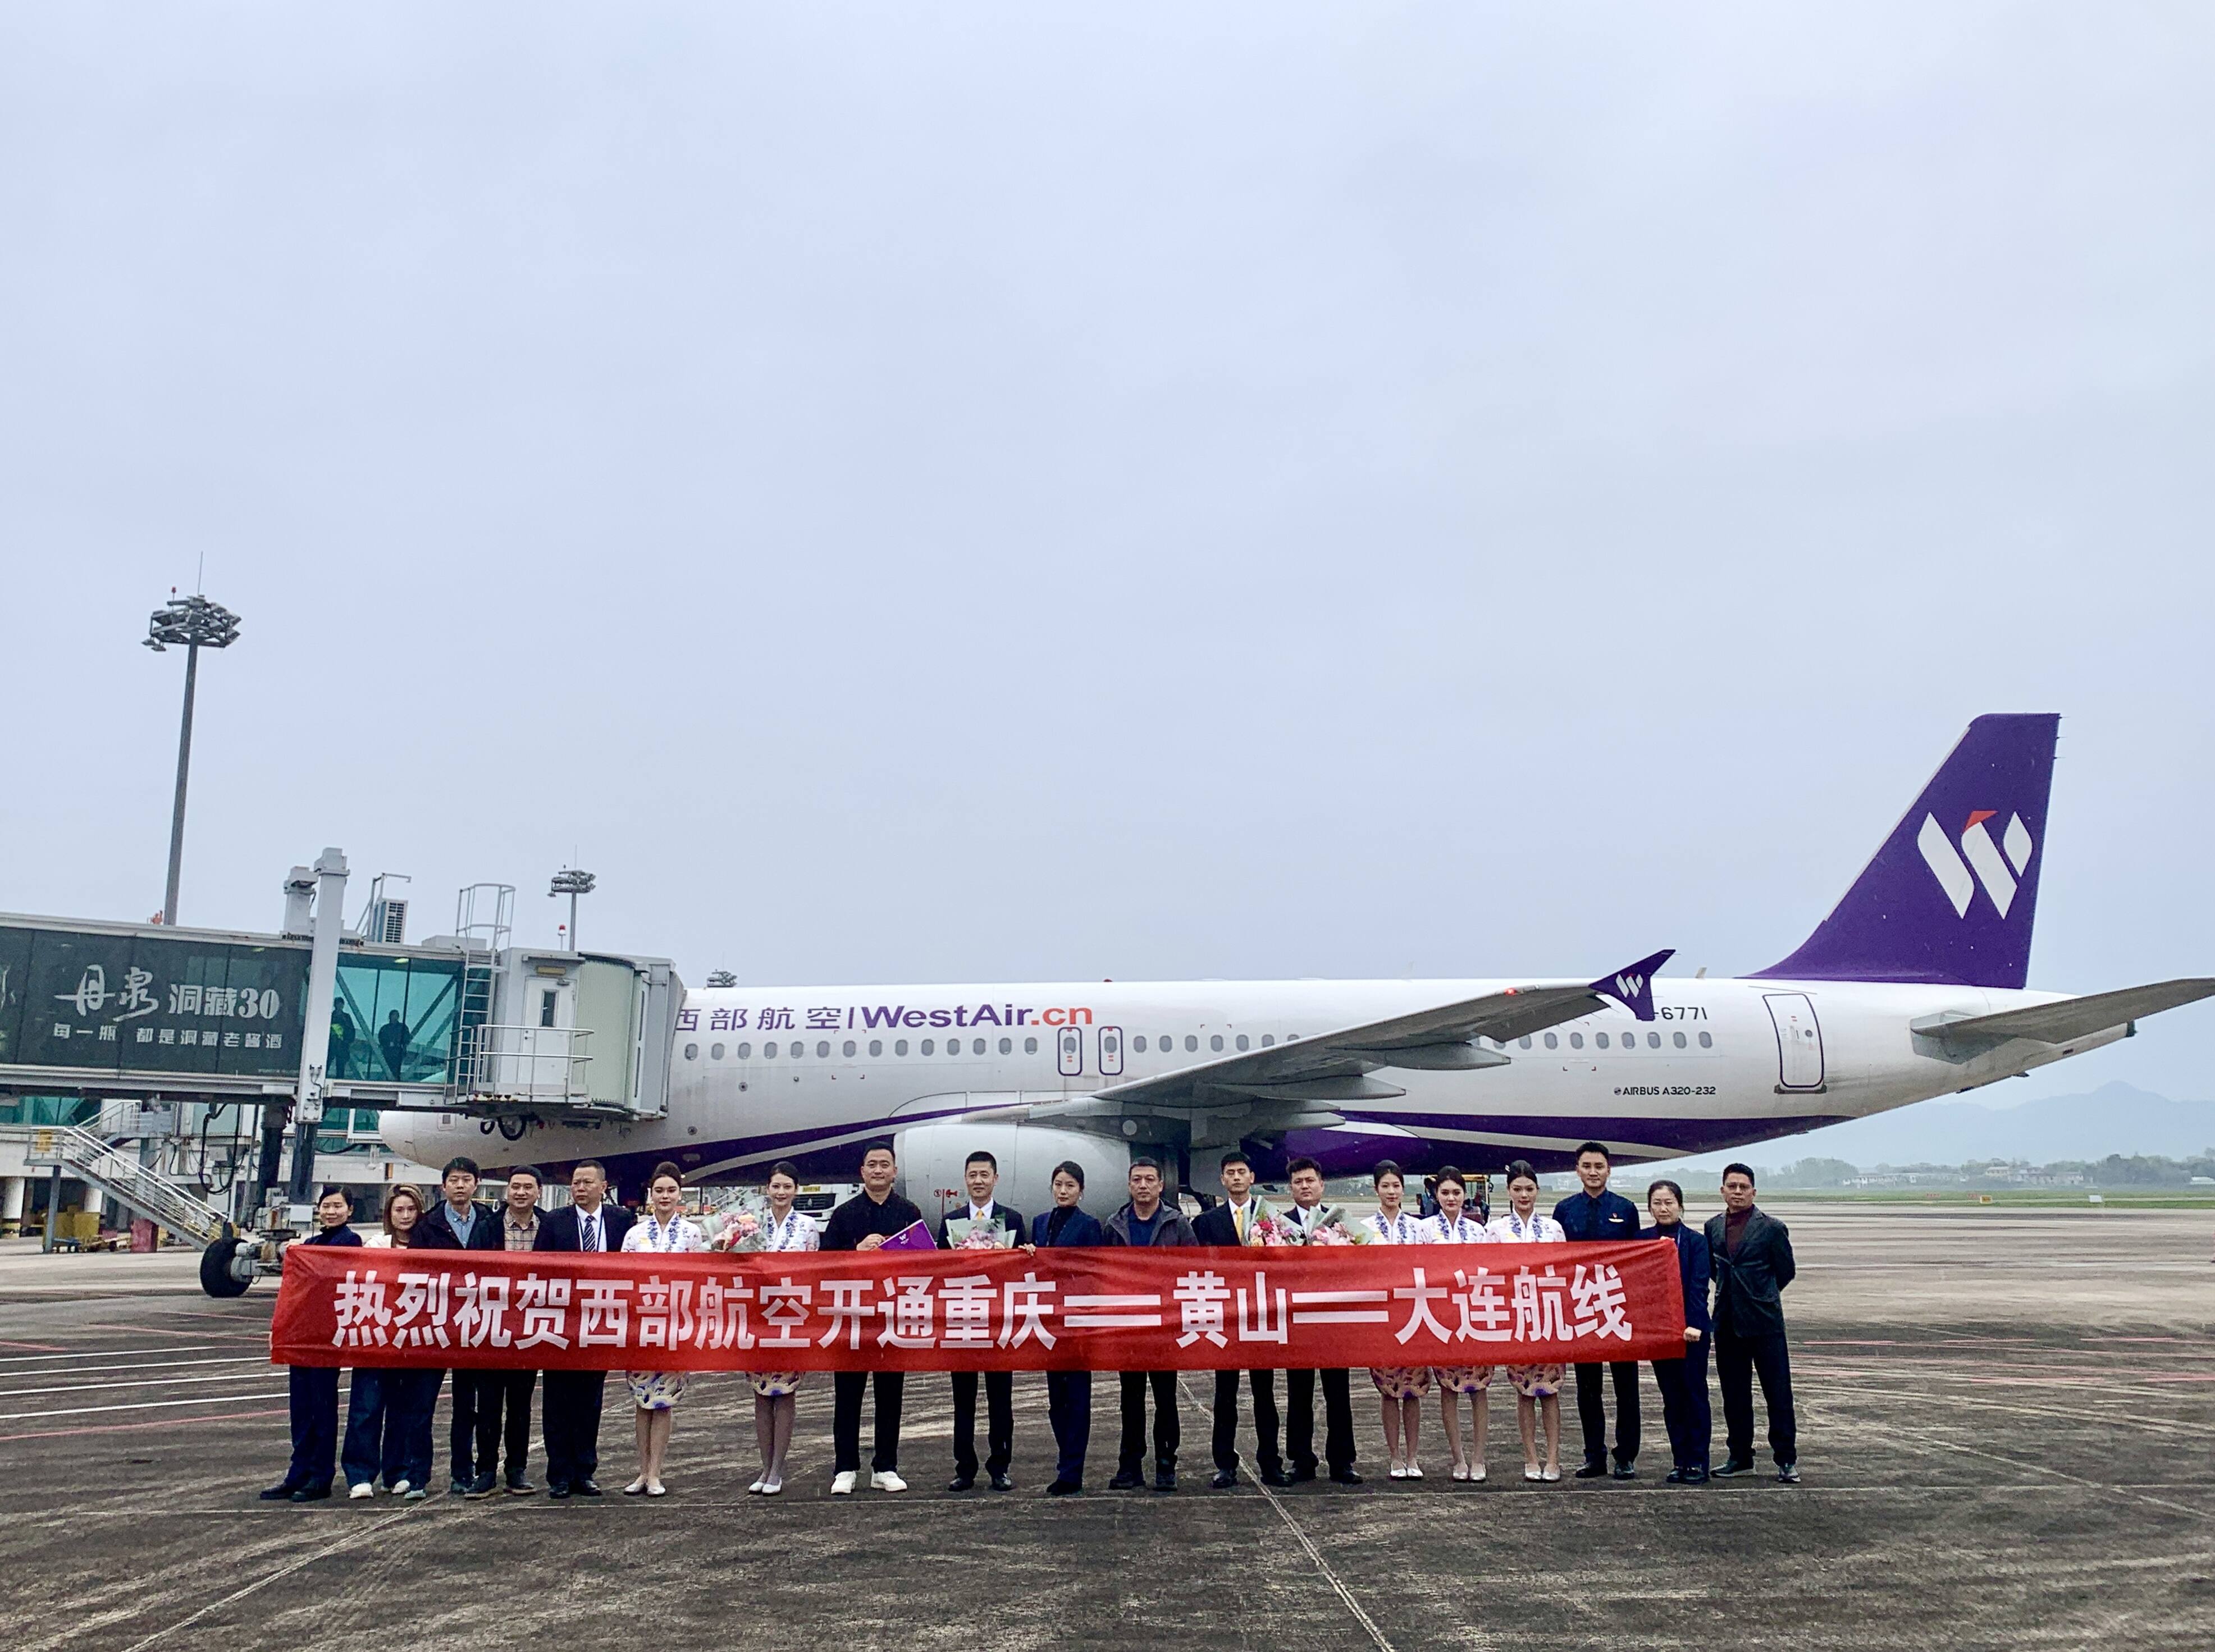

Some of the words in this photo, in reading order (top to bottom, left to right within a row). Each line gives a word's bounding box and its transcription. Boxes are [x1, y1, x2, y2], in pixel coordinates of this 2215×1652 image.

[168, 983, 280, 1019] 洞藏30
[861, 1004, 1093, 1028] WestAir.cn
[1623, 1086, 1660, 1095] AIRBUS
[1662, 1086, 1716, 1095] A320-232
